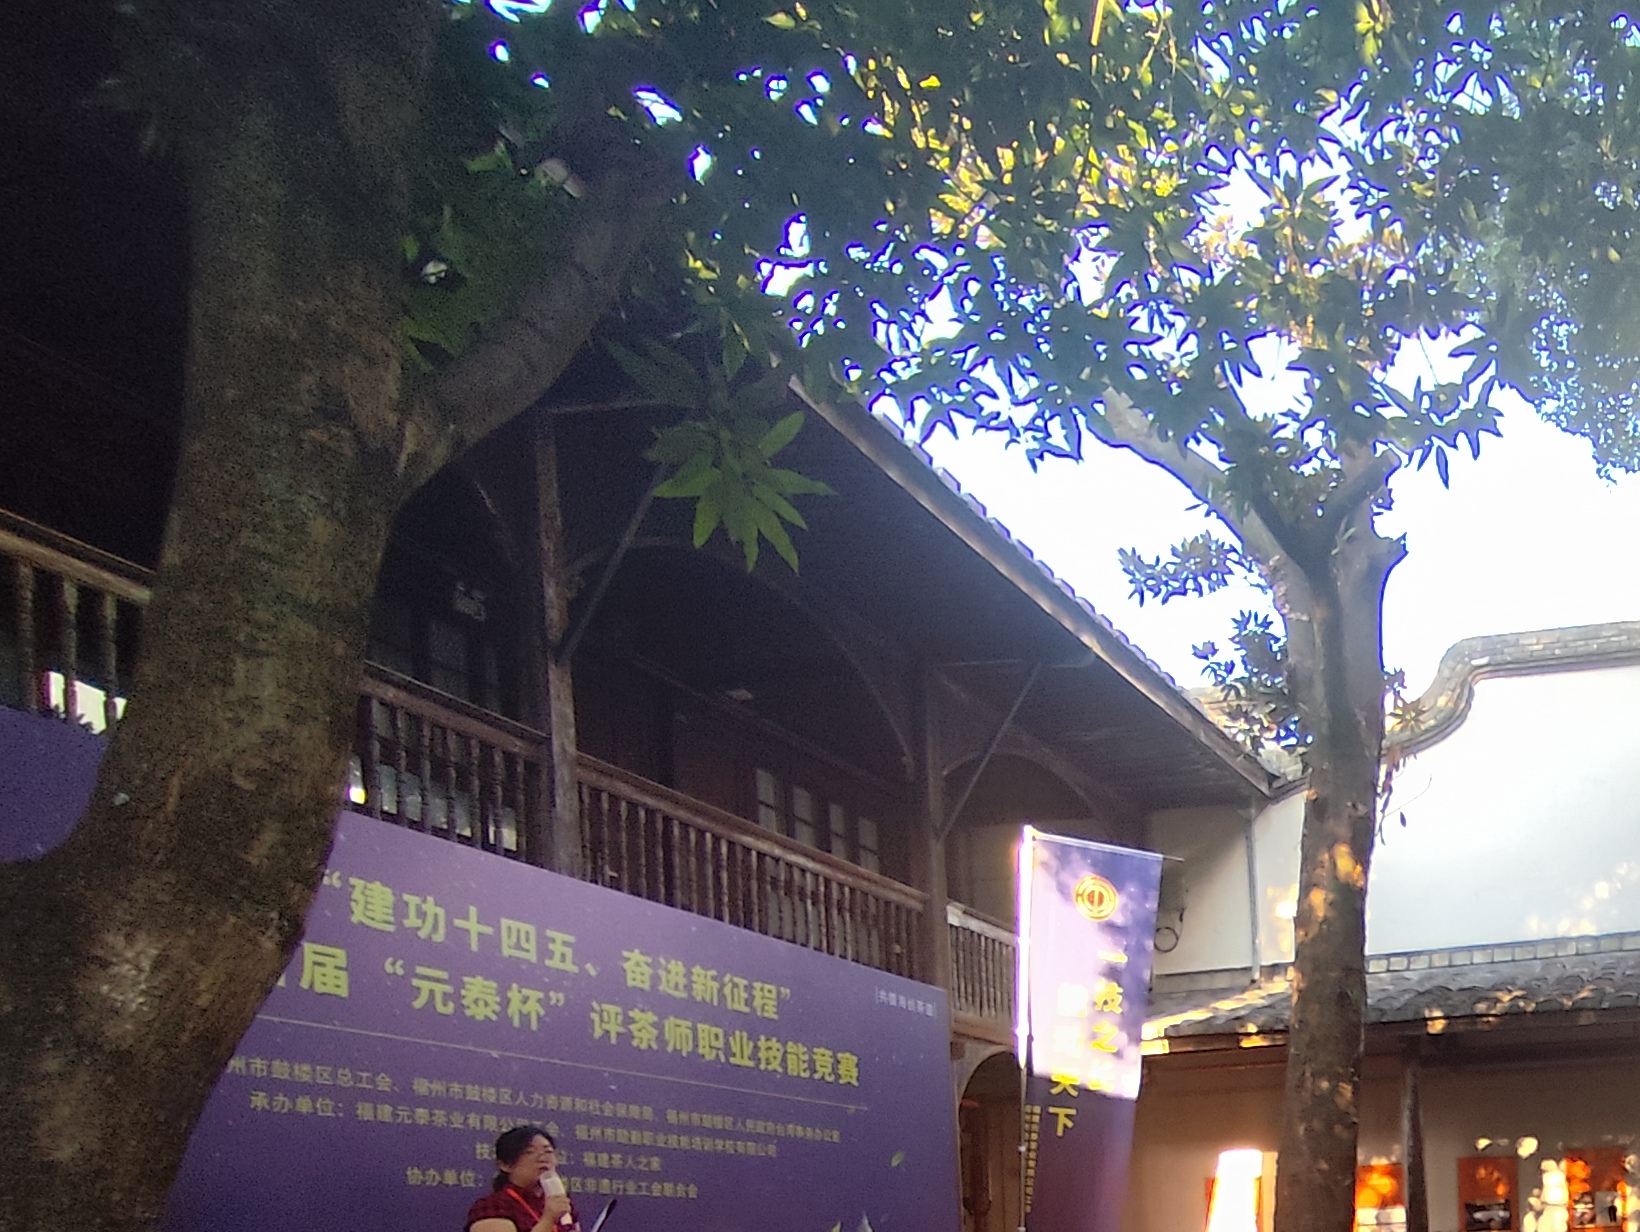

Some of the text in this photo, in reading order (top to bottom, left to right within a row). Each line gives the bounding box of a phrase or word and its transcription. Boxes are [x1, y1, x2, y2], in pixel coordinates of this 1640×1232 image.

[277, 942, 860, 1087] 届“元泰杯”评茶师职业技能竞赛
